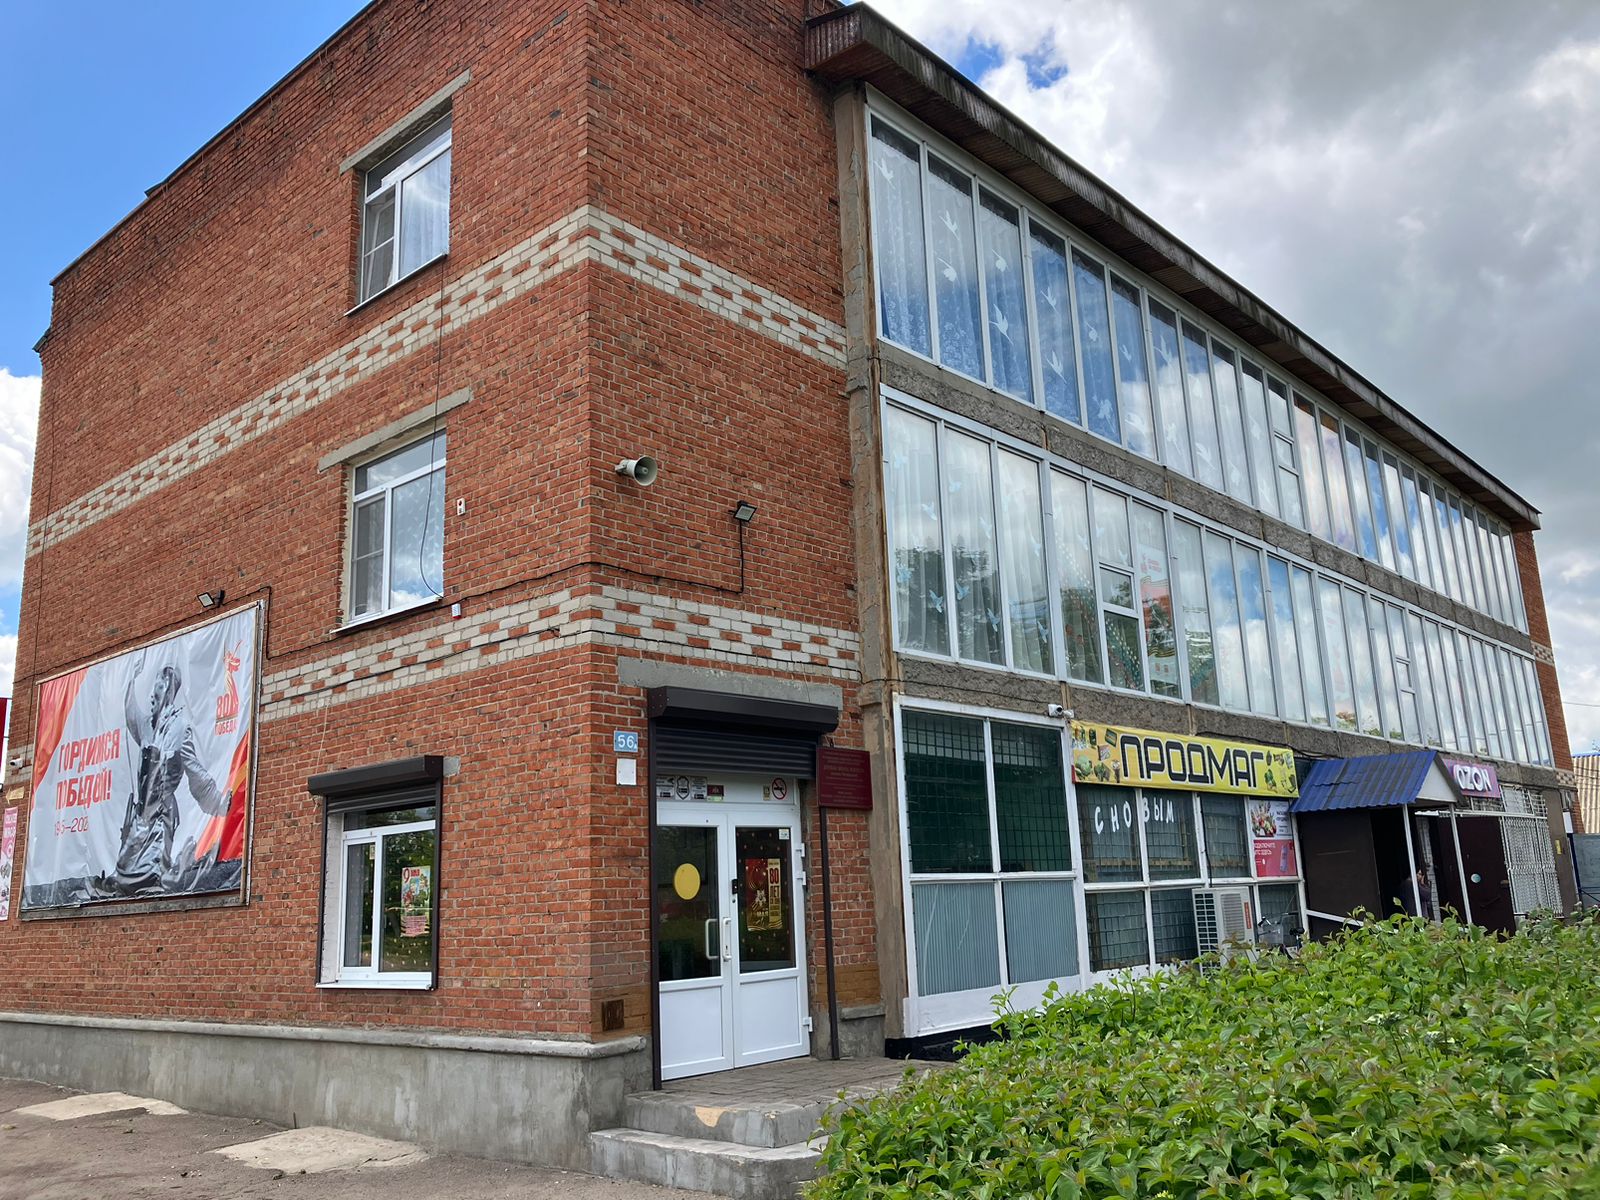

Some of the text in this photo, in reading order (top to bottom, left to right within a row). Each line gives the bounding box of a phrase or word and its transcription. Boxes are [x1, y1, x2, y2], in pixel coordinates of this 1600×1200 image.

[58, 728, 121, 773] ГОРДИМСЯ
[1120, 735, 1264, 788] ПРОДМАГ
[56, 769, 112, 810] ПОБЕДОЙ!
[1453, 764, 1493, 791] OZON
[403, 868, 410, 883] 9
[769, 867, 780, 885] 80
